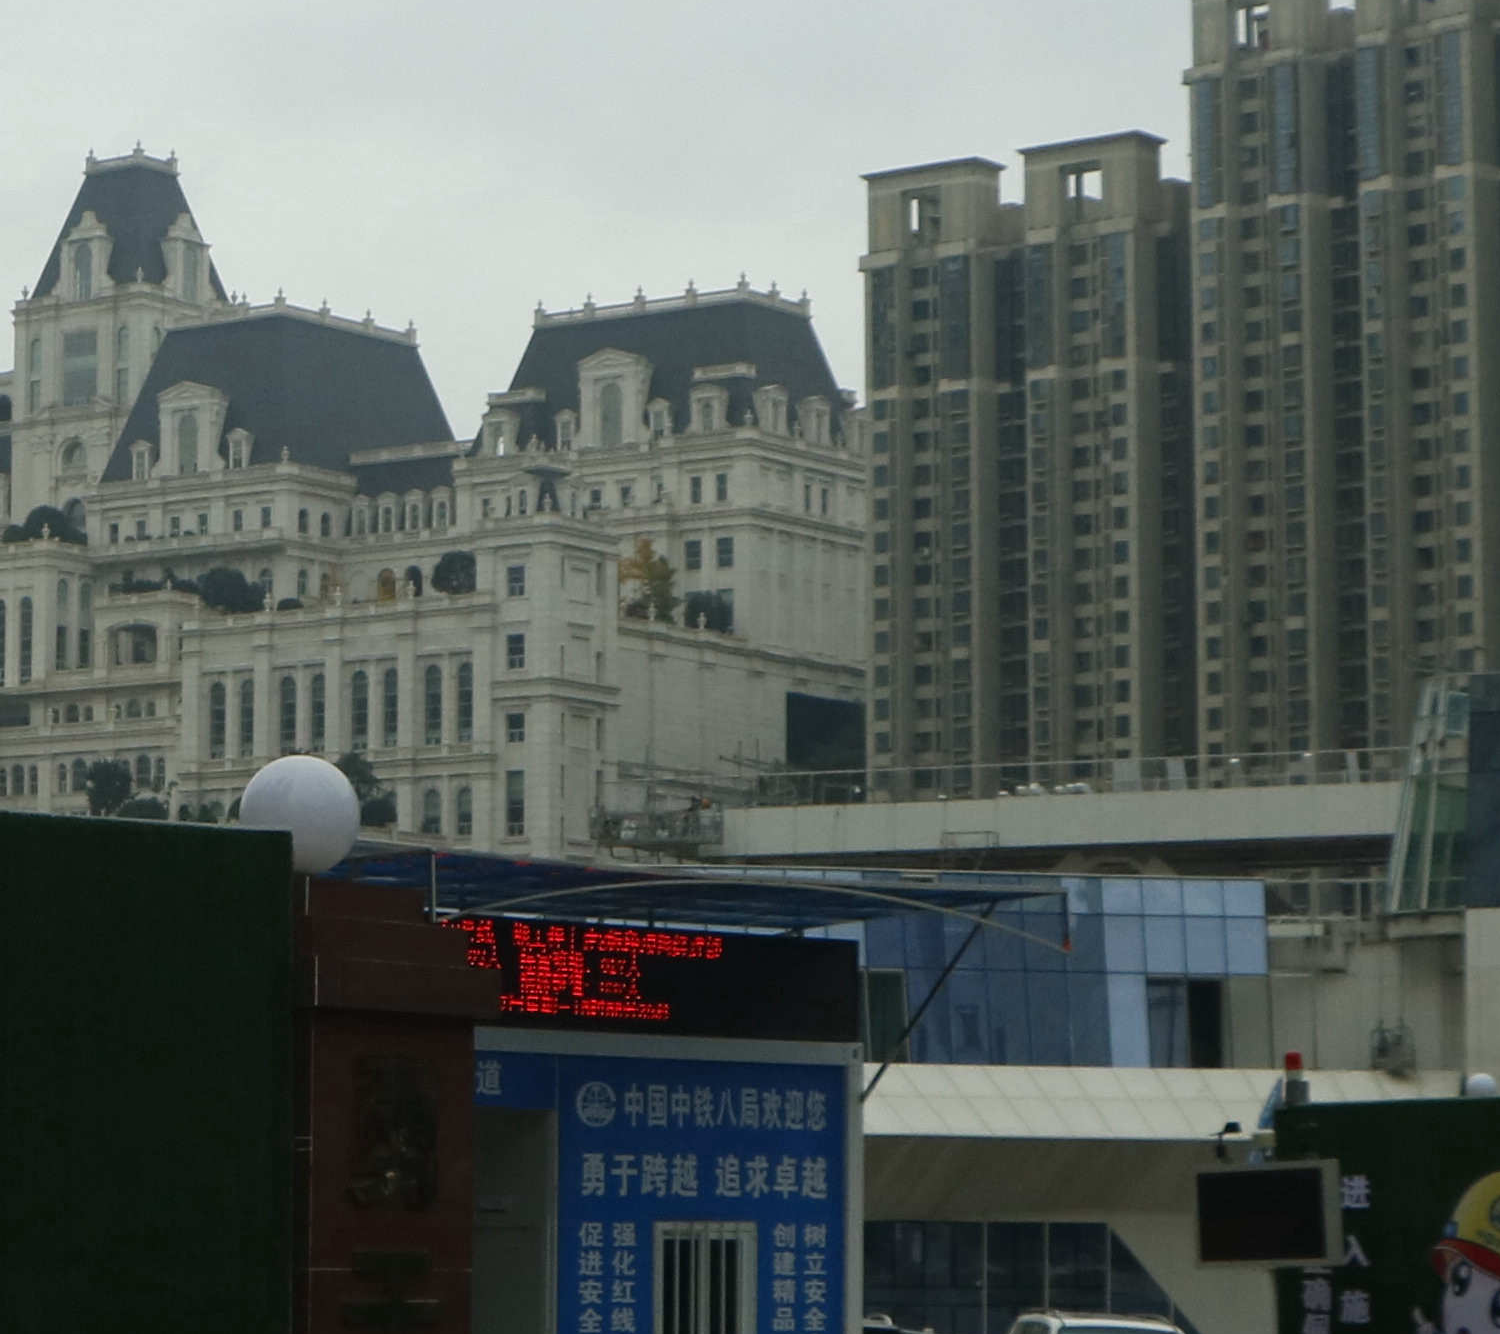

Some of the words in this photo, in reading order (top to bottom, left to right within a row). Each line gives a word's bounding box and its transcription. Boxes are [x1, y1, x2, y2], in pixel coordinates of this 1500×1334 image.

[623, 1082, 827, 1132] 中国中铁八局欢迎您
[580, 1152, 699, 1198] 勇于跨越
[714, 1155, 828, 1200] 追求卓越
